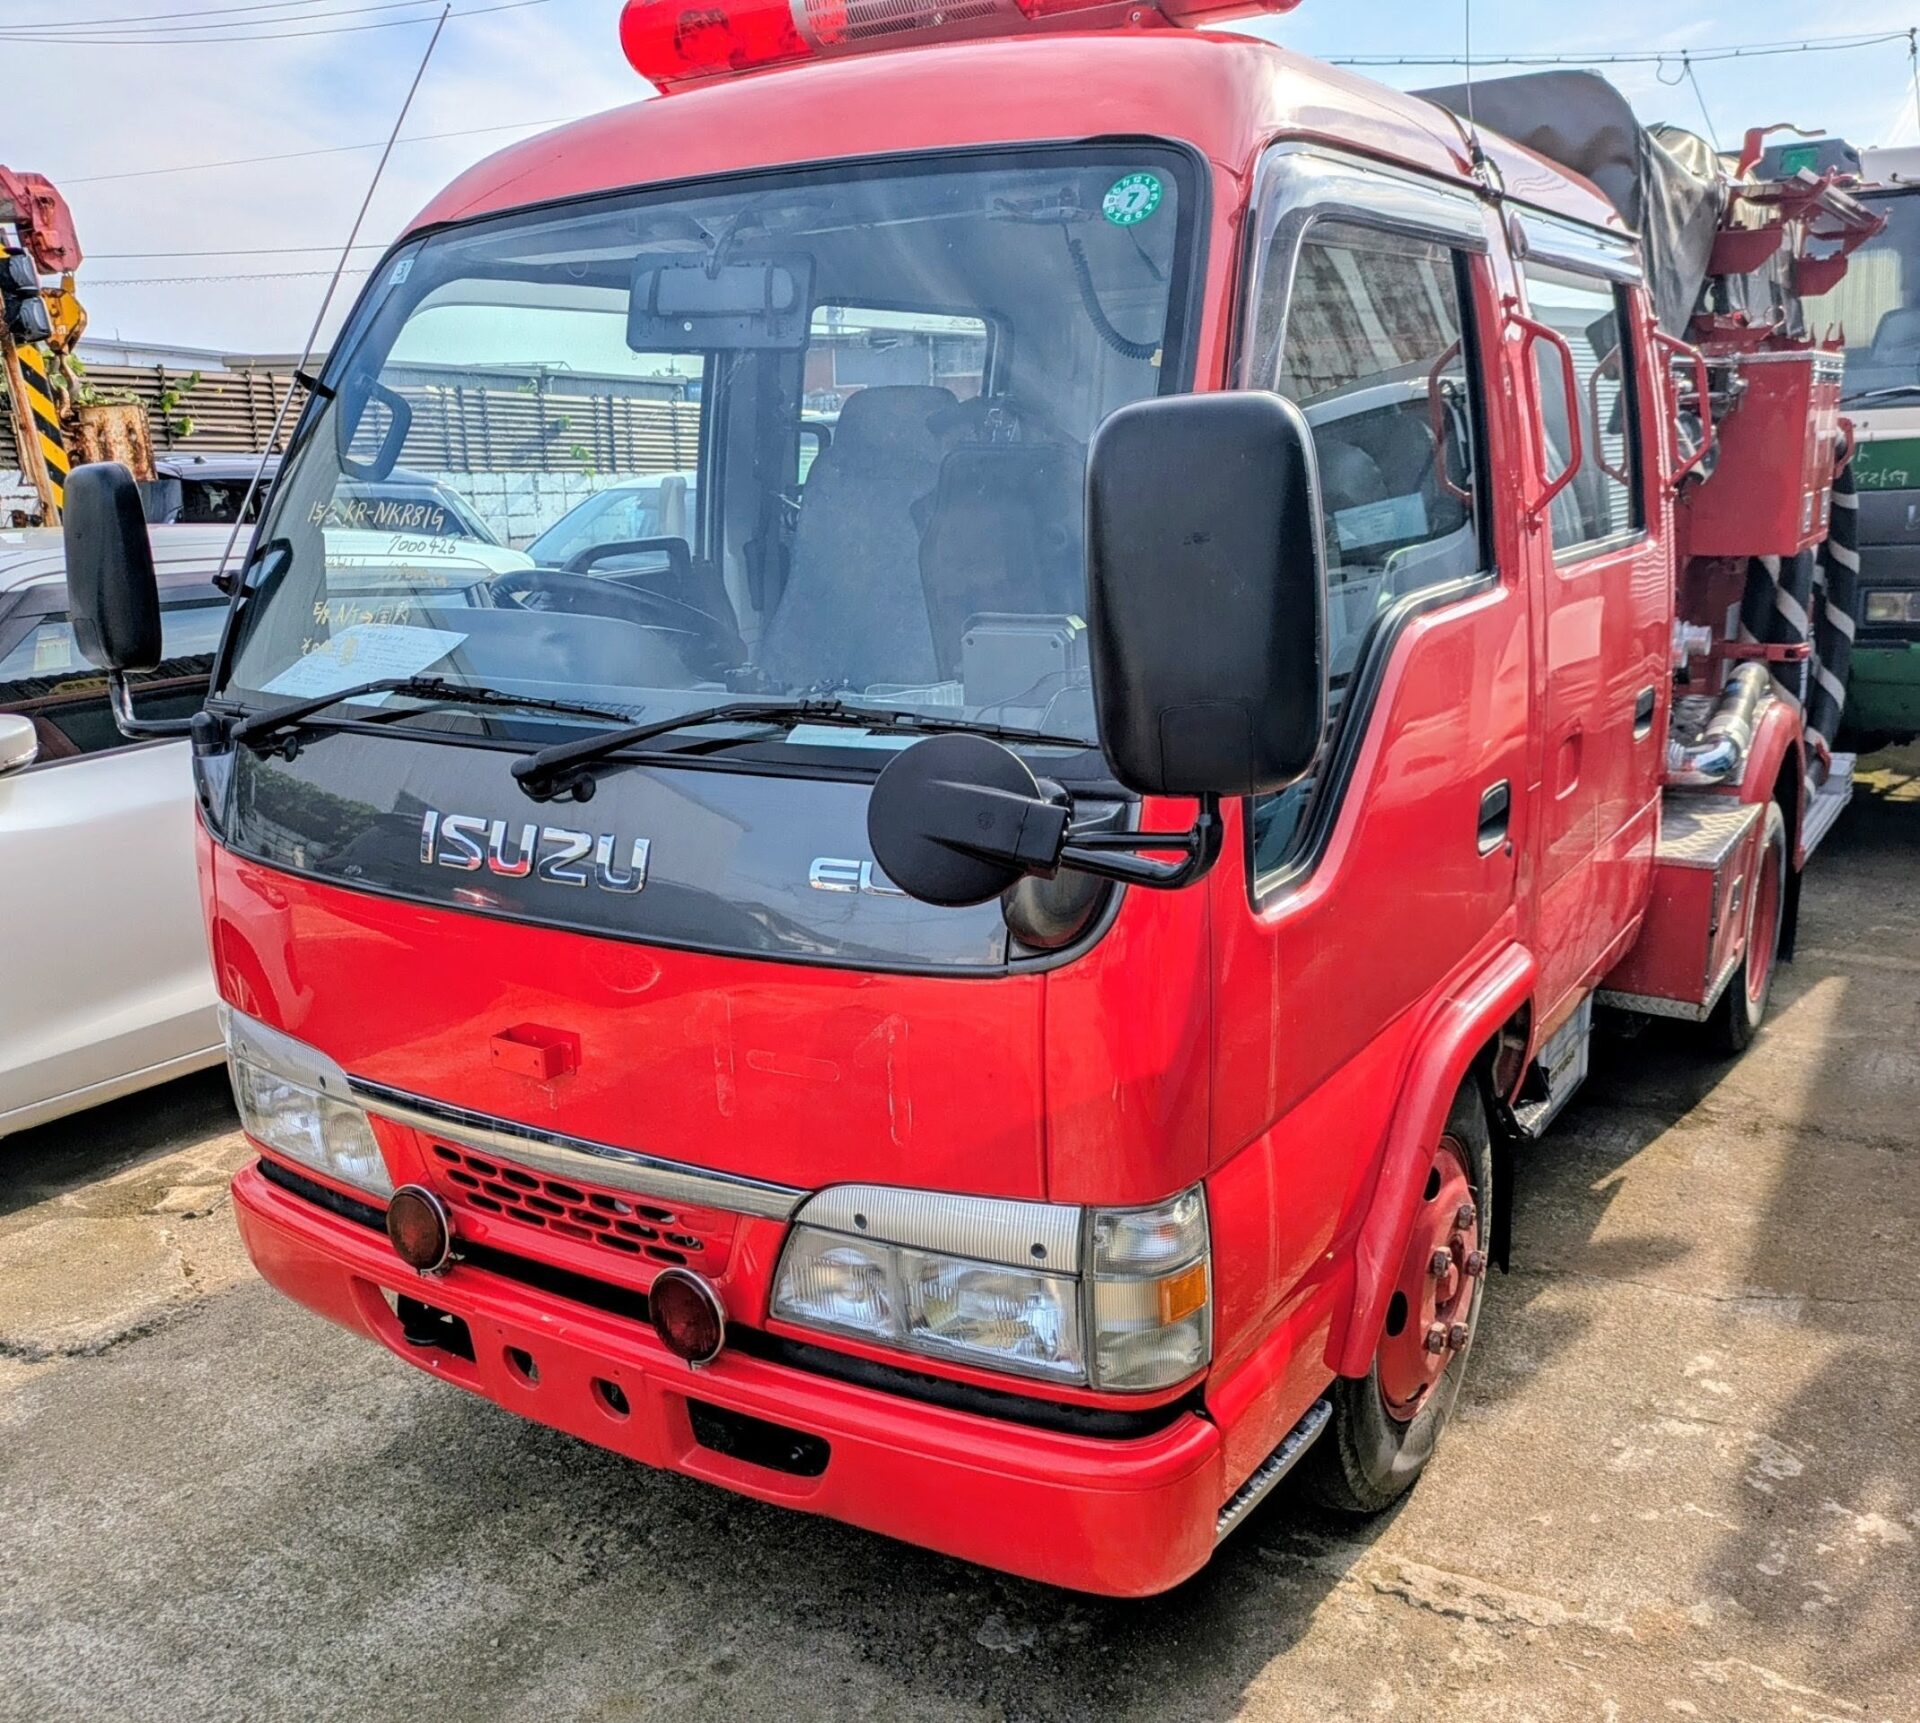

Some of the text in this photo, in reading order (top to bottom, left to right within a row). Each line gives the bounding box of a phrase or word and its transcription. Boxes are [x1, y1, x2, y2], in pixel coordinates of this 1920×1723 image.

[1126, 192, 1139, 208] 7
[420, 810, 913, 898] ISUZU EL
